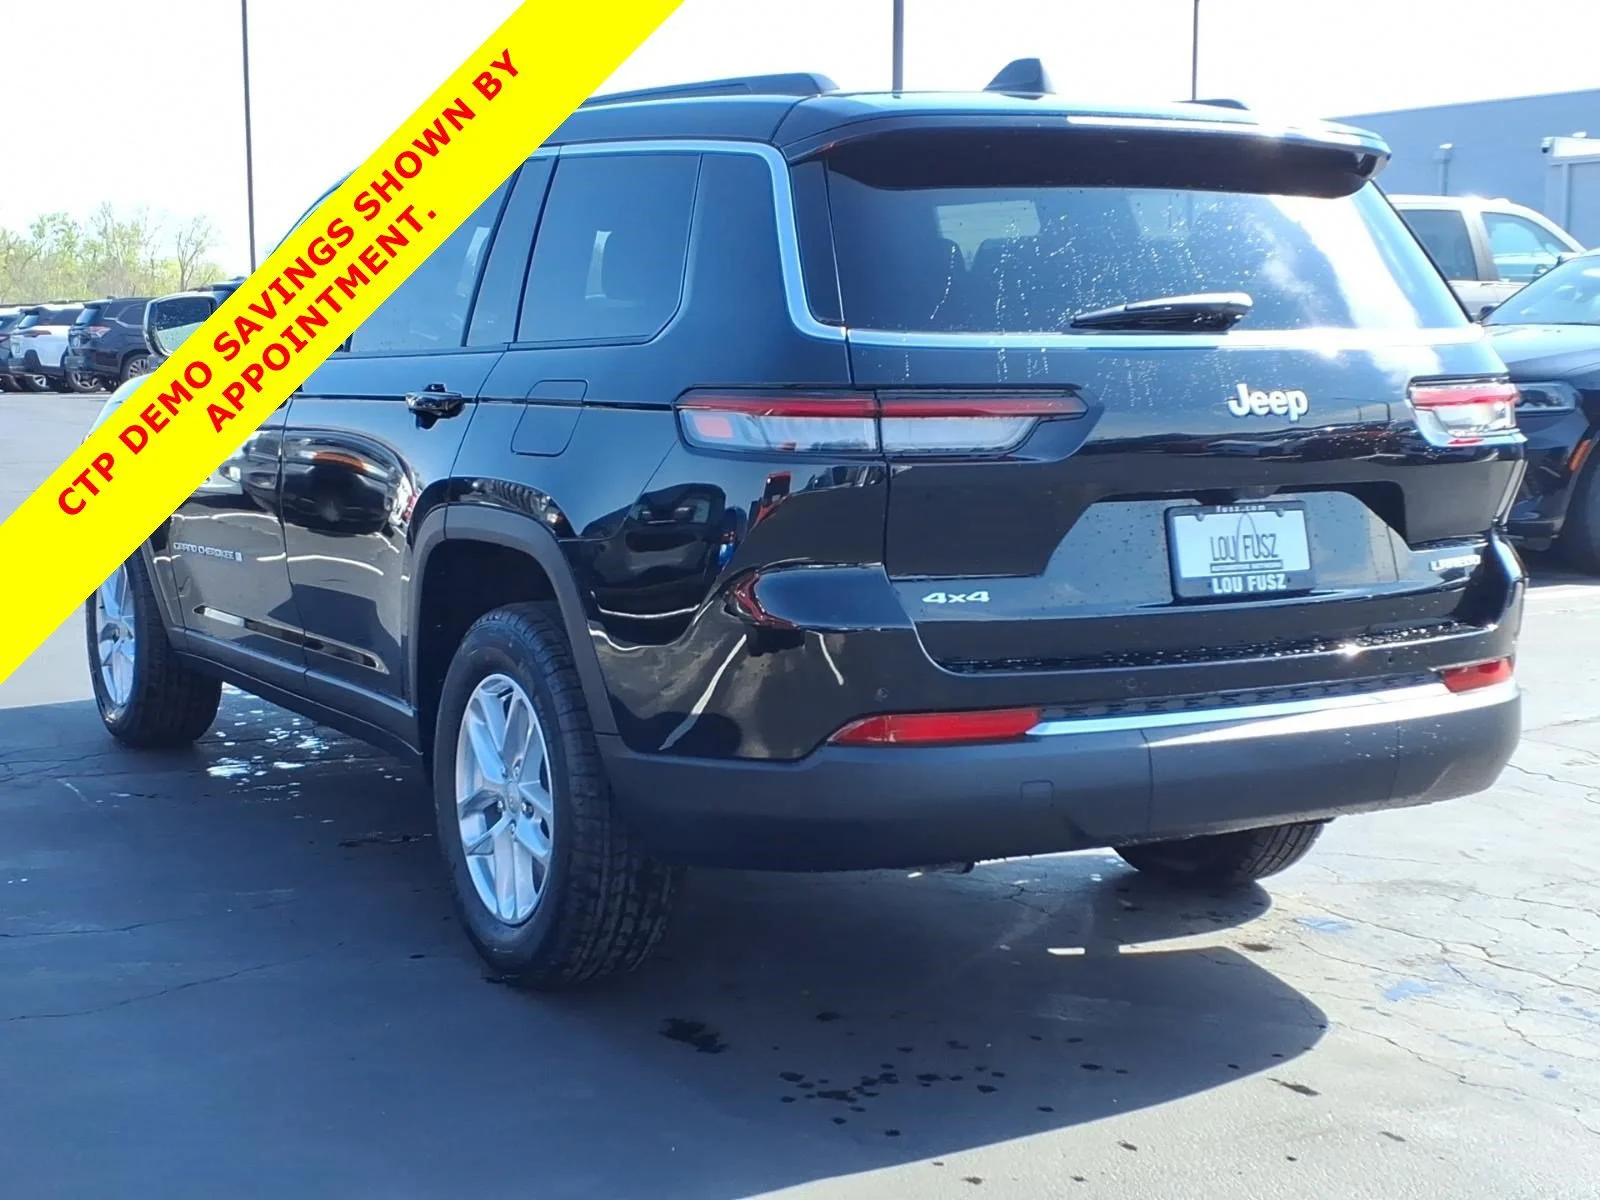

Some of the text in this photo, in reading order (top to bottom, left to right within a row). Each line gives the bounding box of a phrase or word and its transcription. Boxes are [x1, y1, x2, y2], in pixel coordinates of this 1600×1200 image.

[1227, 383, 1308, 422] Jeep
[1210, 533, 1279, 561] LOU FUSZ
[1211, 573, 1287, 594] LOU FUSZ
